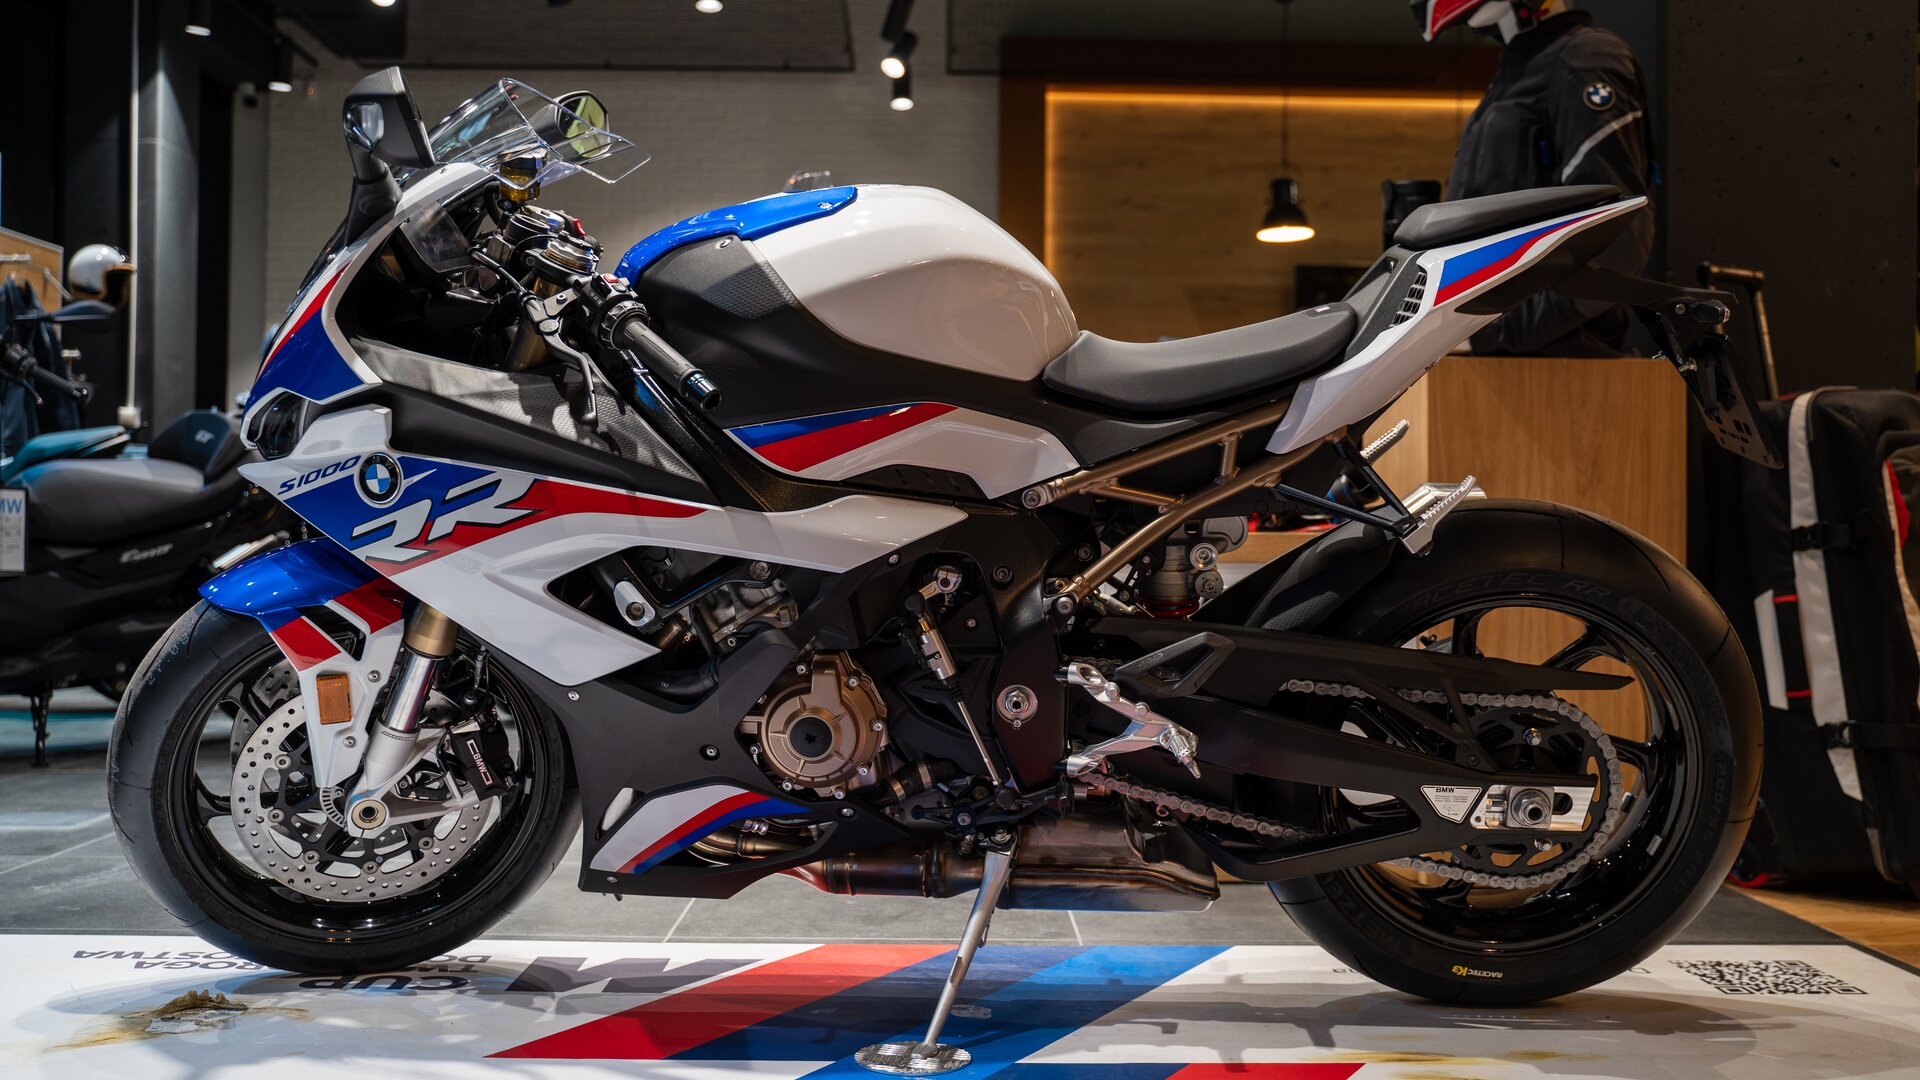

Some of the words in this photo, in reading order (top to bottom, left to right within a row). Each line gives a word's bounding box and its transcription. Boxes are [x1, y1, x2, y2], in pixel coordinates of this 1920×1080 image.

[277, 454, 362, 496] S1000
[0, 497, 22, 514] MW
[351, 473, 540, 565] RR
[473, 754, 488, 773] BMW
[1318, 871, 1400, 950] METZEL
[73, 950, 234, 959] OSTWA
[134, 961, 264, 970] ROGA
[418, 964, 478, 973] TW
[1451, 965, 1468, 977] K3
[1467, 968, 1503, 978] RACETEC
[298, 975, 468, 991] CUP
